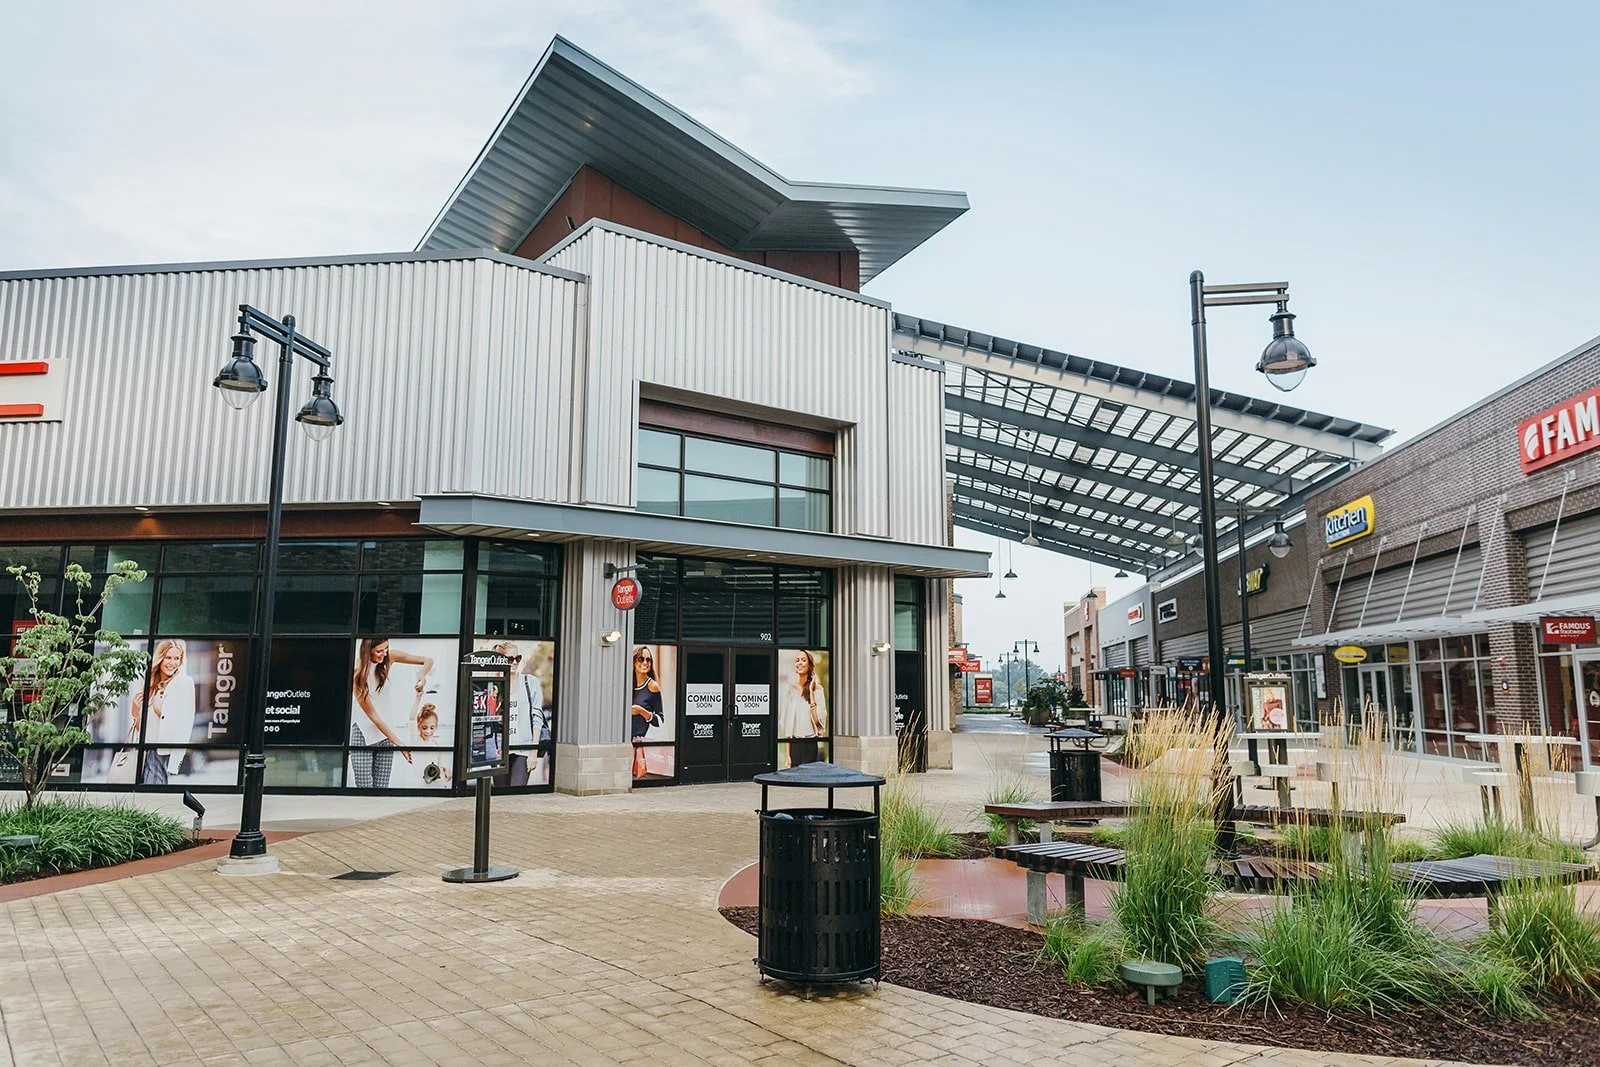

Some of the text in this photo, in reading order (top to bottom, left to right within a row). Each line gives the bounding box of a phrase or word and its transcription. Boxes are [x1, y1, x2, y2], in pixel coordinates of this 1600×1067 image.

[616, 584, 634, 595] Tanger
[616, 594, 635, 604] Outlets
[1559, 622, 1591, 630] FAMOUS
[760, 632, 772, 641] 902
[470, 654, 509, 667] TangerOutlets
[1247, 672, 1288, 680] TangerOutlets
[207, 646, 236, 739] Tanger
[266, 689, 311, 700] angerOutlets
[687, 694, 722, 703] COMING
[735, 694, 769, 703] COMING
[265, 704, 301, 715] et social
[693, 722, 714, 731] Tanger
[741, 721, 761, 730] Tanger
